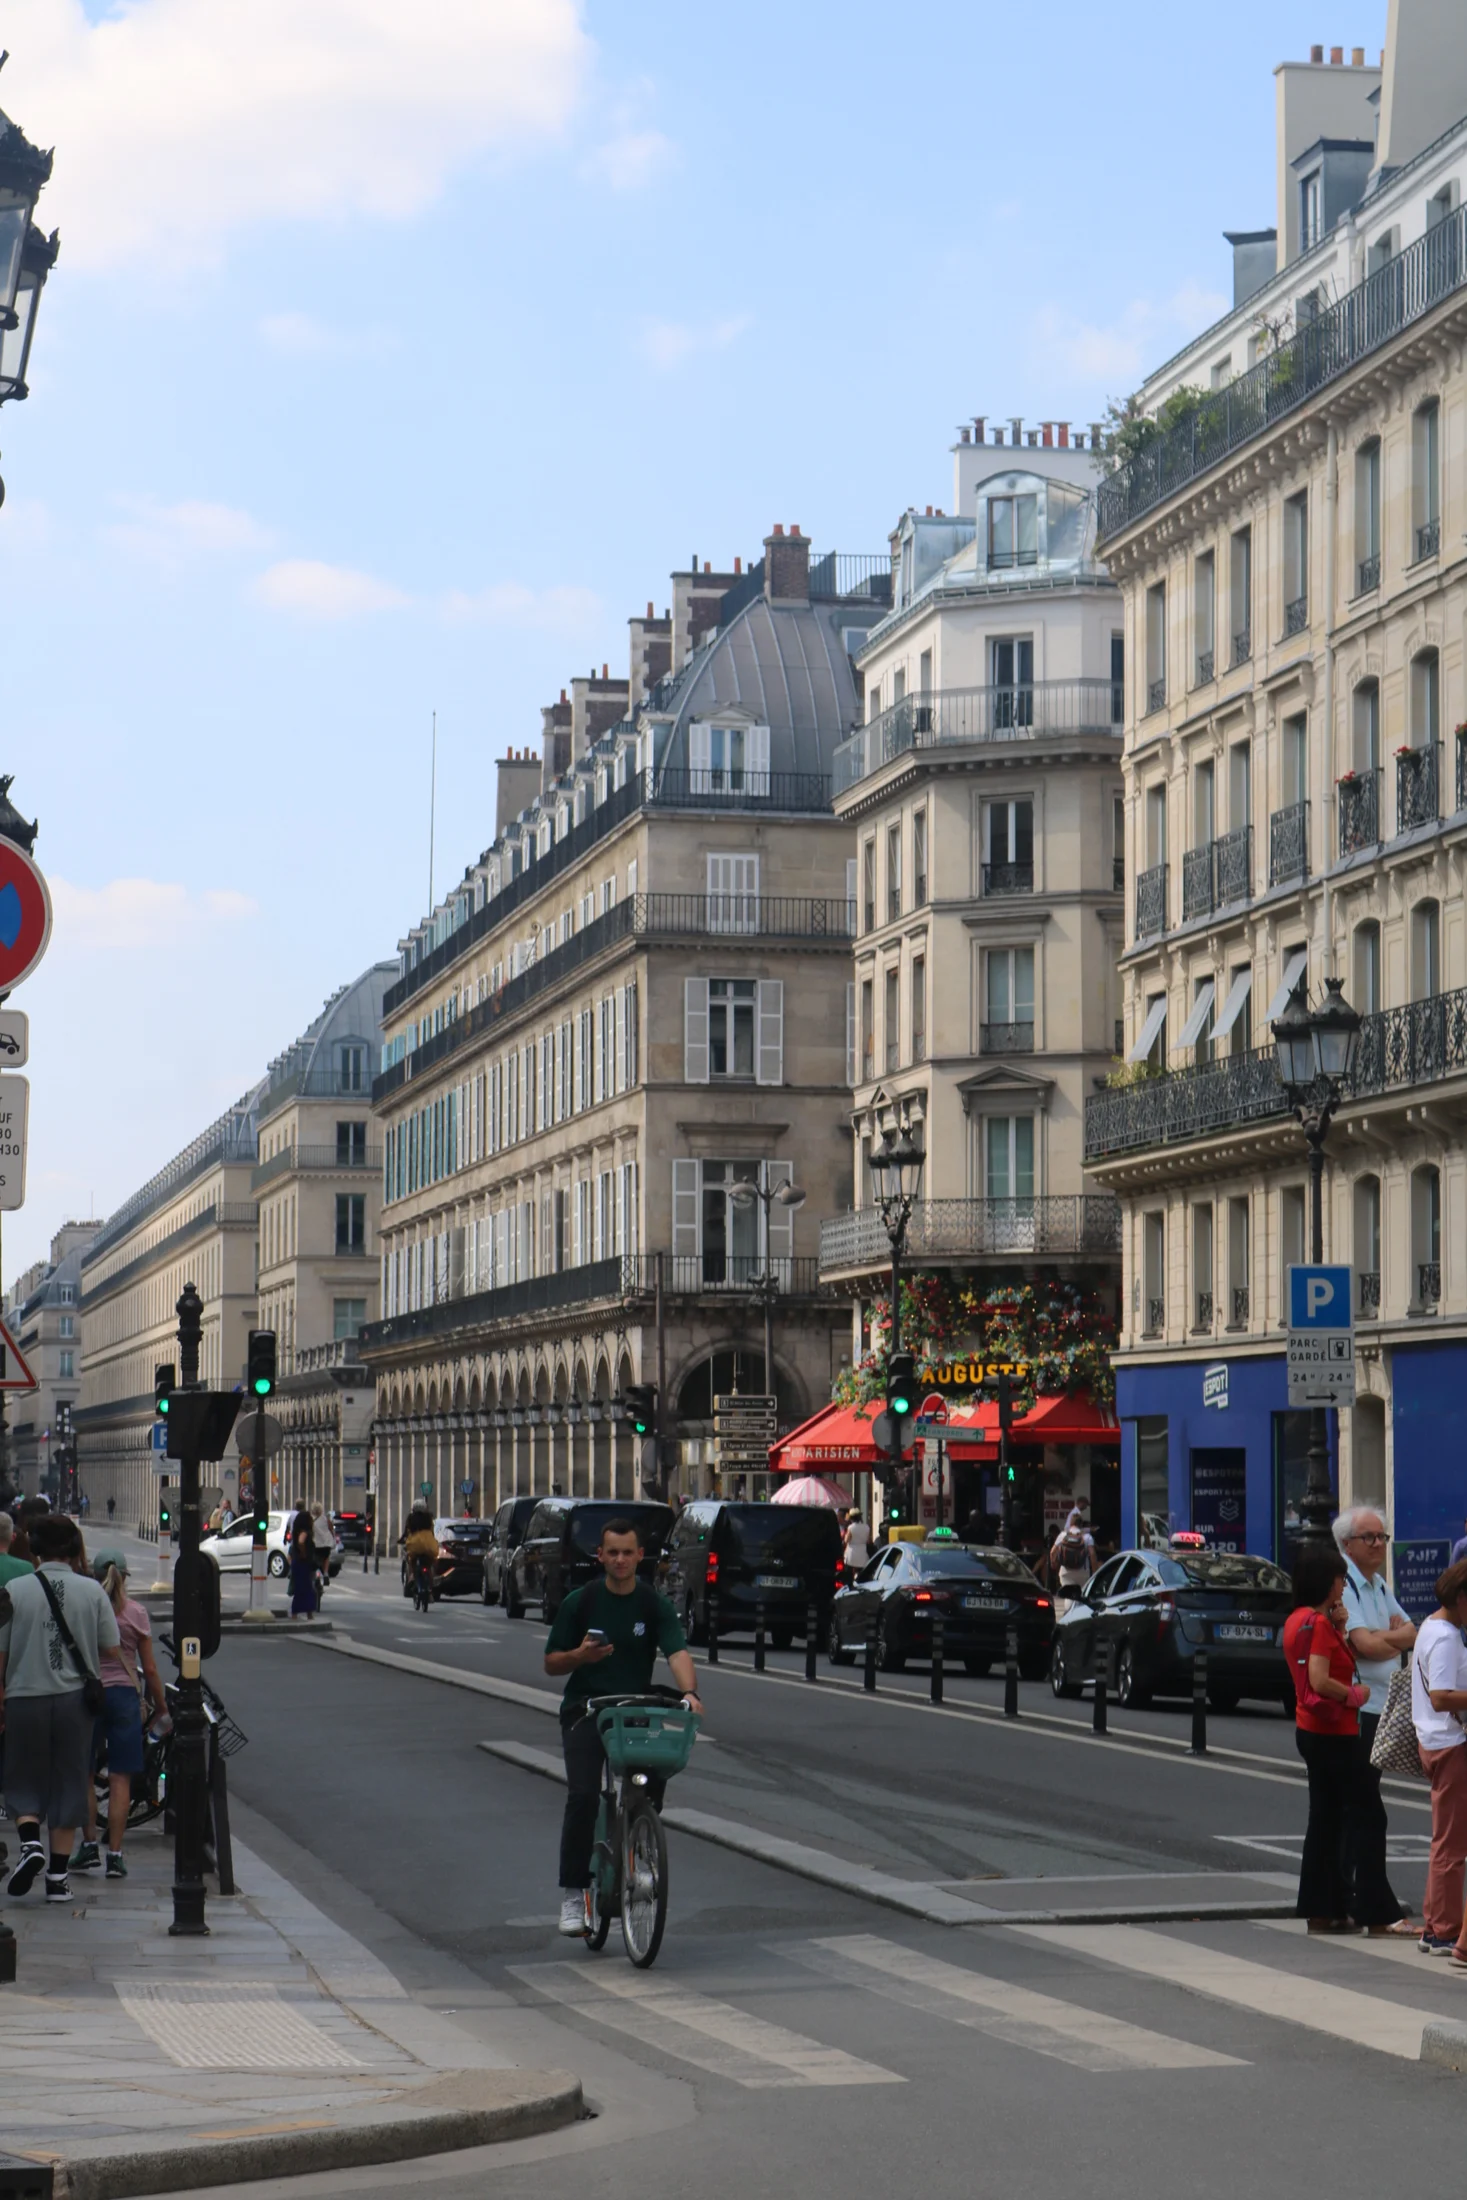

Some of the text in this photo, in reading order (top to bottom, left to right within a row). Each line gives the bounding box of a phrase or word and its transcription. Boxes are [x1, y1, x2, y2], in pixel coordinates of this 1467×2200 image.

[1307, 1278, 1335, 1318] P
[1290, 1338, 1318, 1348] PARC
[1290, 1350, 1327, 1361] GARDÉ
[921, 1362, 1030, 1384] AUGUSTE
[1205, 1373, 1225, 1397] ESPOT
[1194, 1524, 1214, 1534] SUR
[1180, 1535, 1200, 1543] TAXI
[1407, 1568, 1417, 1576] DE
